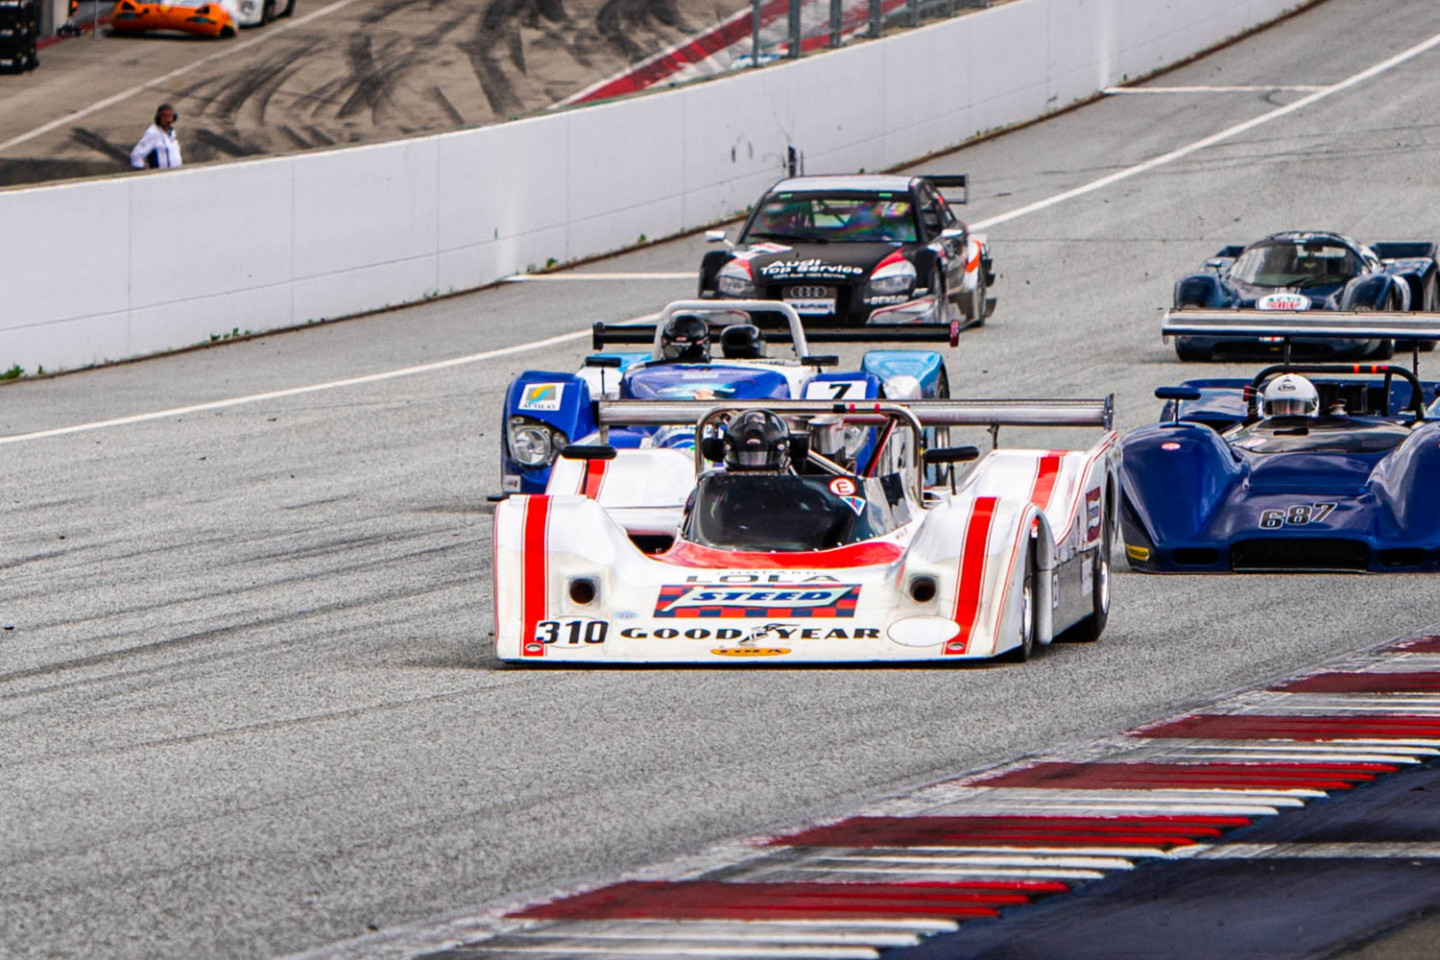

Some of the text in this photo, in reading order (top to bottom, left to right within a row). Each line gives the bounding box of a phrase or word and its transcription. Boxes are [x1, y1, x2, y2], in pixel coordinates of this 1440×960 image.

[760, 264, 863, 275] Top Service
[767, 259, 821, 269] Audi
[829, 383, 852, 400] 7
[836, 482, 850, 493] E
[1258, 502, 1338, 530] 687
[686, 575, 841, 583] LOLA
[692, 591, 832, 601] STEED
[536, 620, 609, 645] 310
